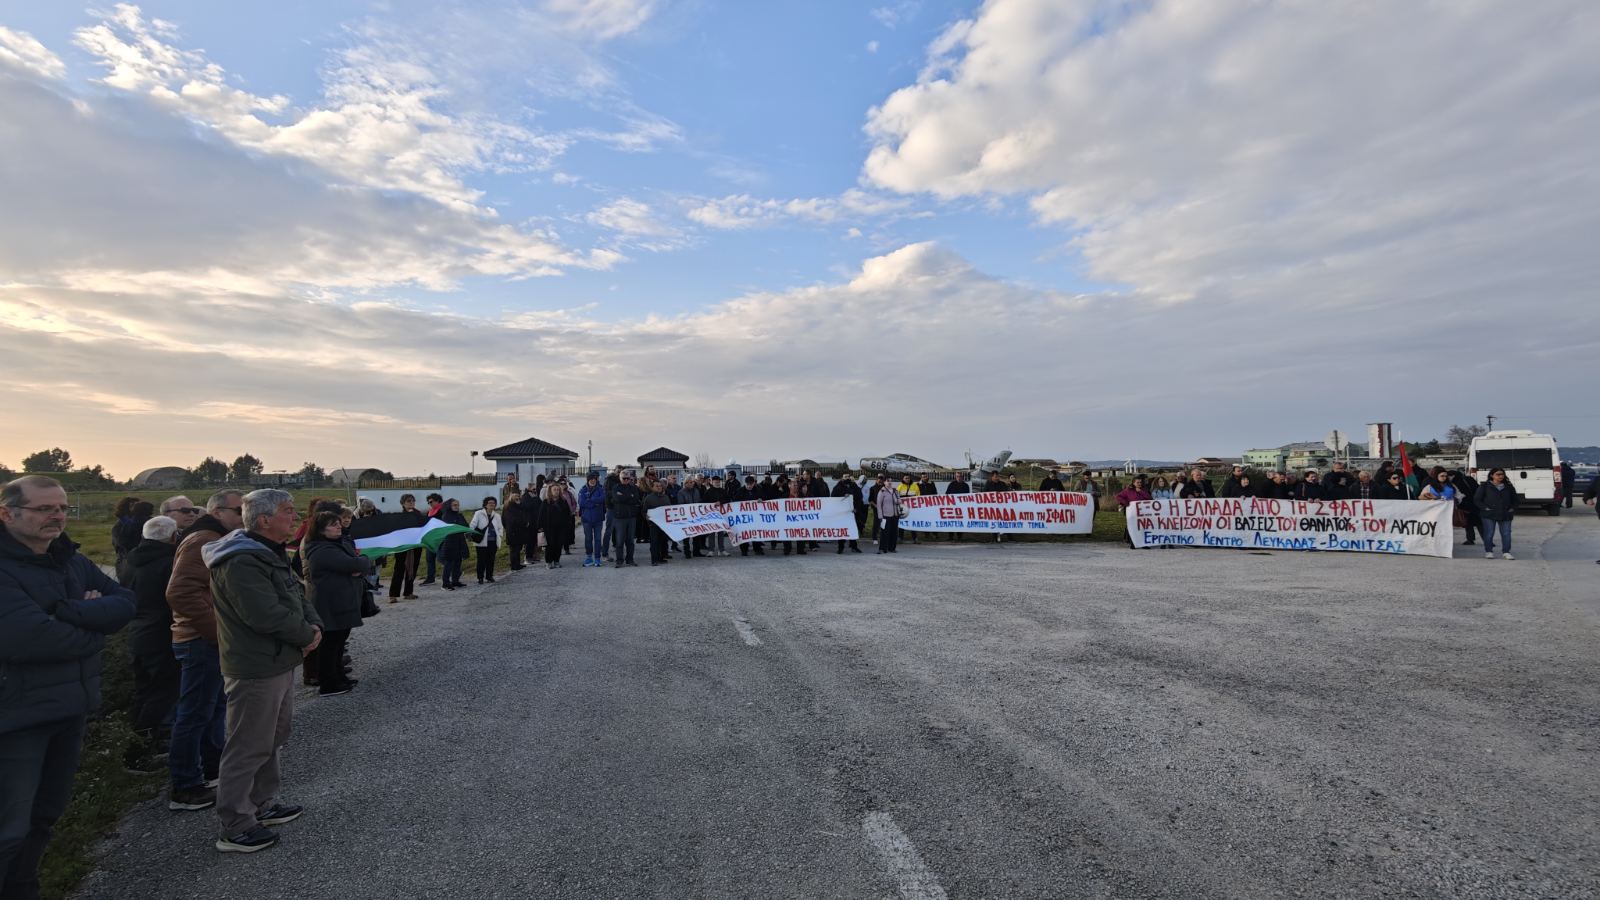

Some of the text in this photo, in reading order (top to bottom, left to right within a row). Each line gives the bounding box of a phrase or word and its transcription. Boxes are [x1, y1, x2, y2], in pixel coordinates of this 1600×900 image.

[870, 461, 888, 471] 689
[665, 507, 687, 523] ΕΞΩ
[740, 501, 758, 512] ΑΠΟ
[762, 501, 779, 512] ΤΟΝ
[784, 499, 822, 512] ΠΟΛΕΜΟ
[939, 507, 964, 519] ΕΞΩ
[967, 507, 976, 519] Η
[977, 506, 1017, 521] ΕΛΛΑΔΑ
[1018, 511, 1035, 521] ΑΠΟ
[1045, 508, 1076, 523] ΣΦΑΓΗ
[1136, 501, 1162, 517] ΕΞΩ
[1169, 500, 1180, 517] Η
[1185, 499, 1243, 517] ΕΛΛΑΔΑ
[1250, 497, 1281, 516] ΑΠΟ
[1313, 501, 1374, 516] ΣΦΑΓΗ
[728, 513, 754, 527] ΒΑΣΗ
[759, 513, 776, 523] ΤΟΥ
[786, 513, 821, 522] ΑΚΤΙΟΥ
[1137, 517, 1153, 531] ΝΑ
[1157, 516, 1213, 531] ΚΛΕΙΣΟΥΝ
[1216, 516, 1232, 530] ΟΙ
[1234, 516, 1278, 532] ΒΑΣΕΙΣ
[1276, 516, 1298, 531] ΤΟΥ
[1300, 516, 1351, 532] ΘΑΝΑΤΟΥ
[1361, 518, 1387, 533] ΤΟΥ
[1390, 519, 1438, 537] ΑΚΤΙΟΥ
[784, 528, 811, 538] ΤΟΜΕΑ
[812, 528, 850, 538] ΠΡΕΒΕΖΑΣ
[1144, 531, 1195, 545] ΕΡΓΑΤΙΚΟ
[1203, 530, 1243, 547] ΚΕΝΤΡΟ
